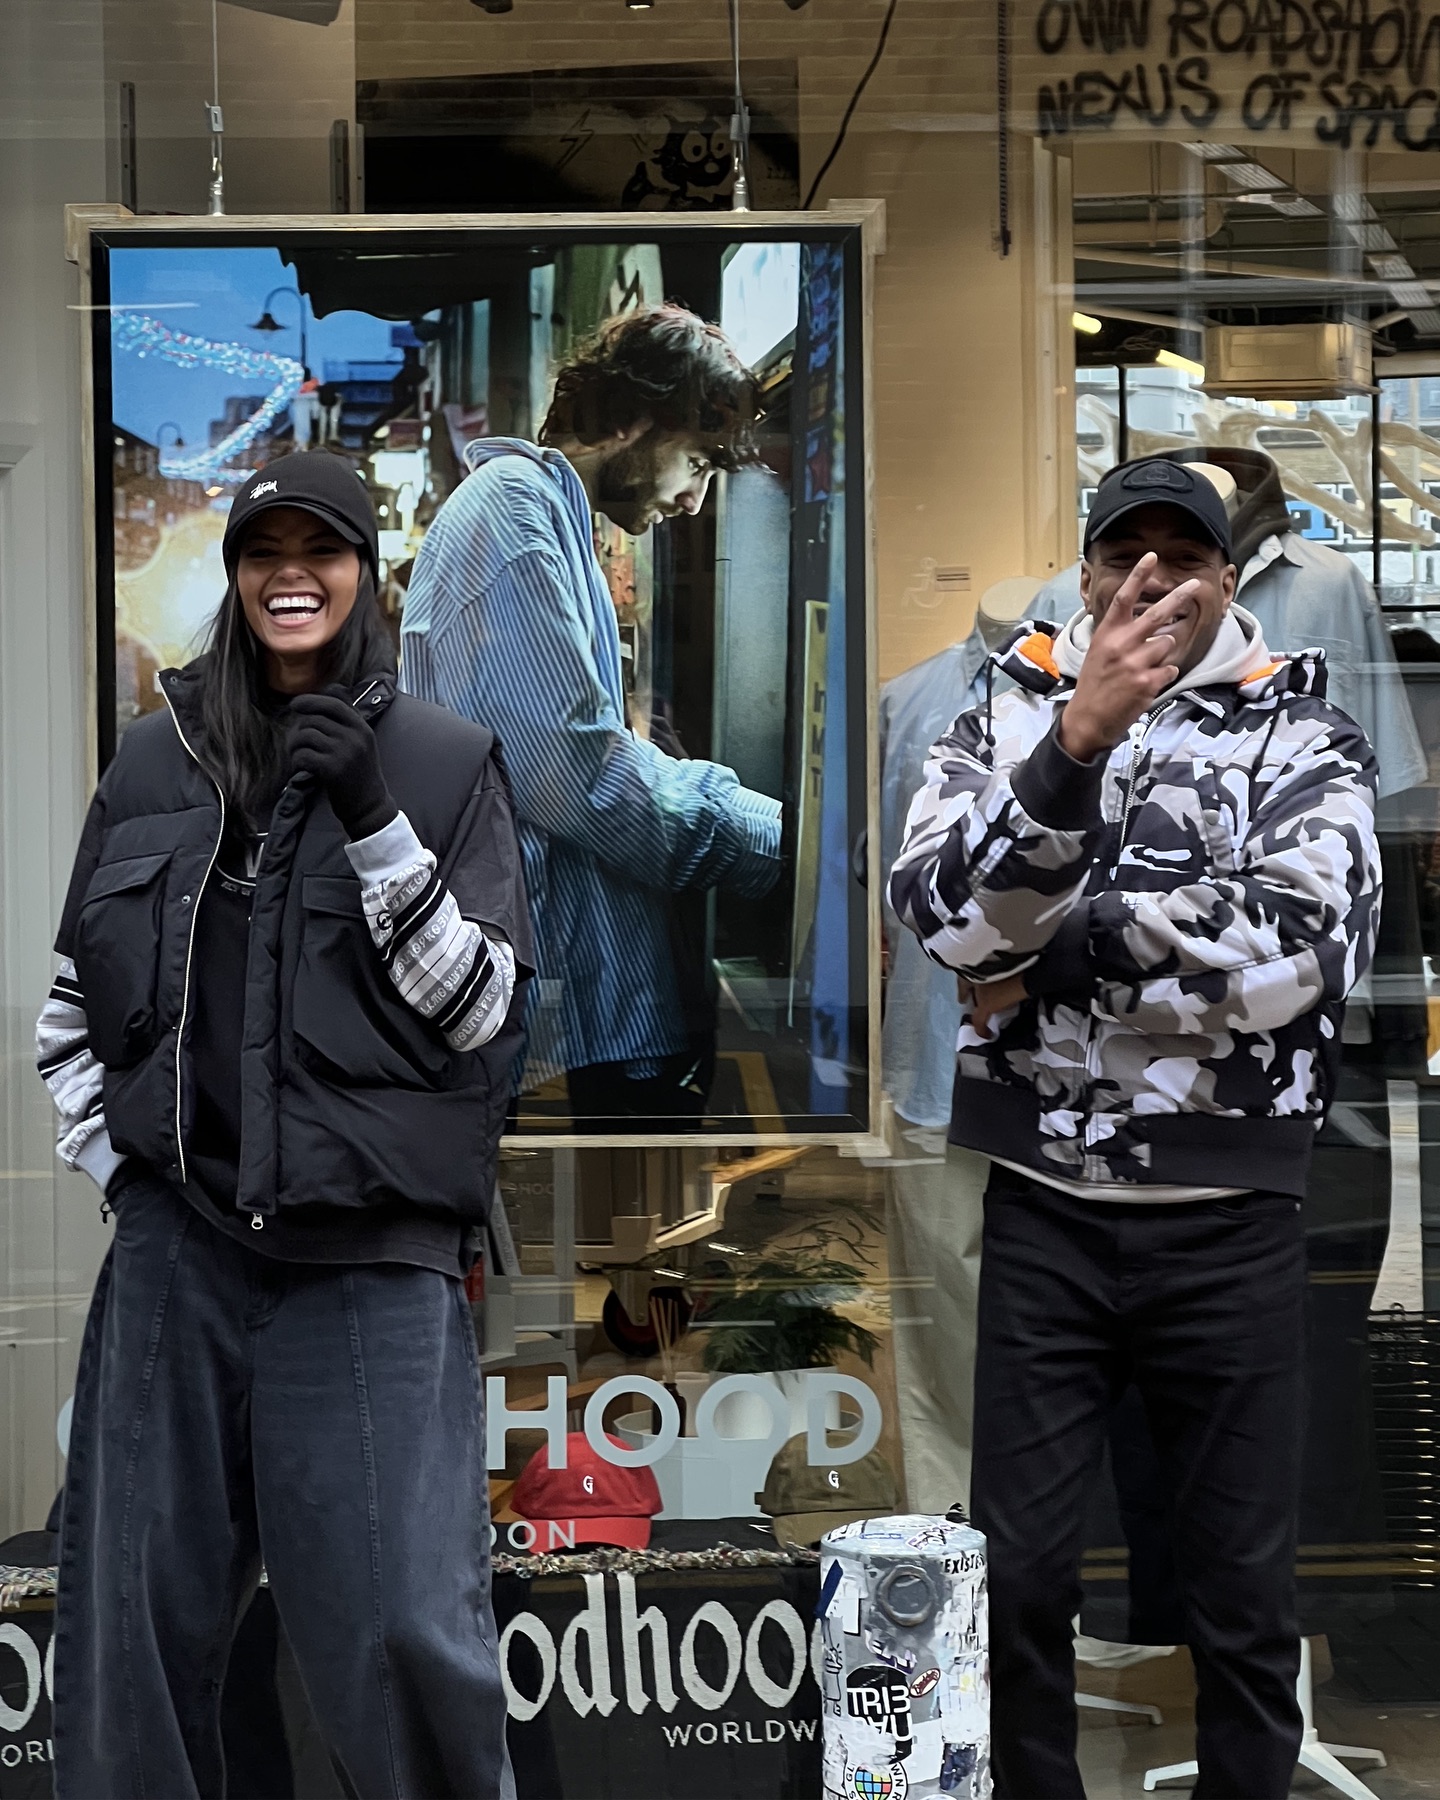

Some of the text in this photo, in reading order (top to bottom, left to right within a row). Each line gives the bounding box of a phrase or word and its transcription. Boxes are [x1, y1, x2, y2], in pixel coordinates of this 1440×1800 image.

[1037, 0, 1150, 54] OWN
[1037, 57, 1221, 137] NEXUS
[1241, 71, 1312, 131] OF
[499, 1571, 823, 1722] odhoo
